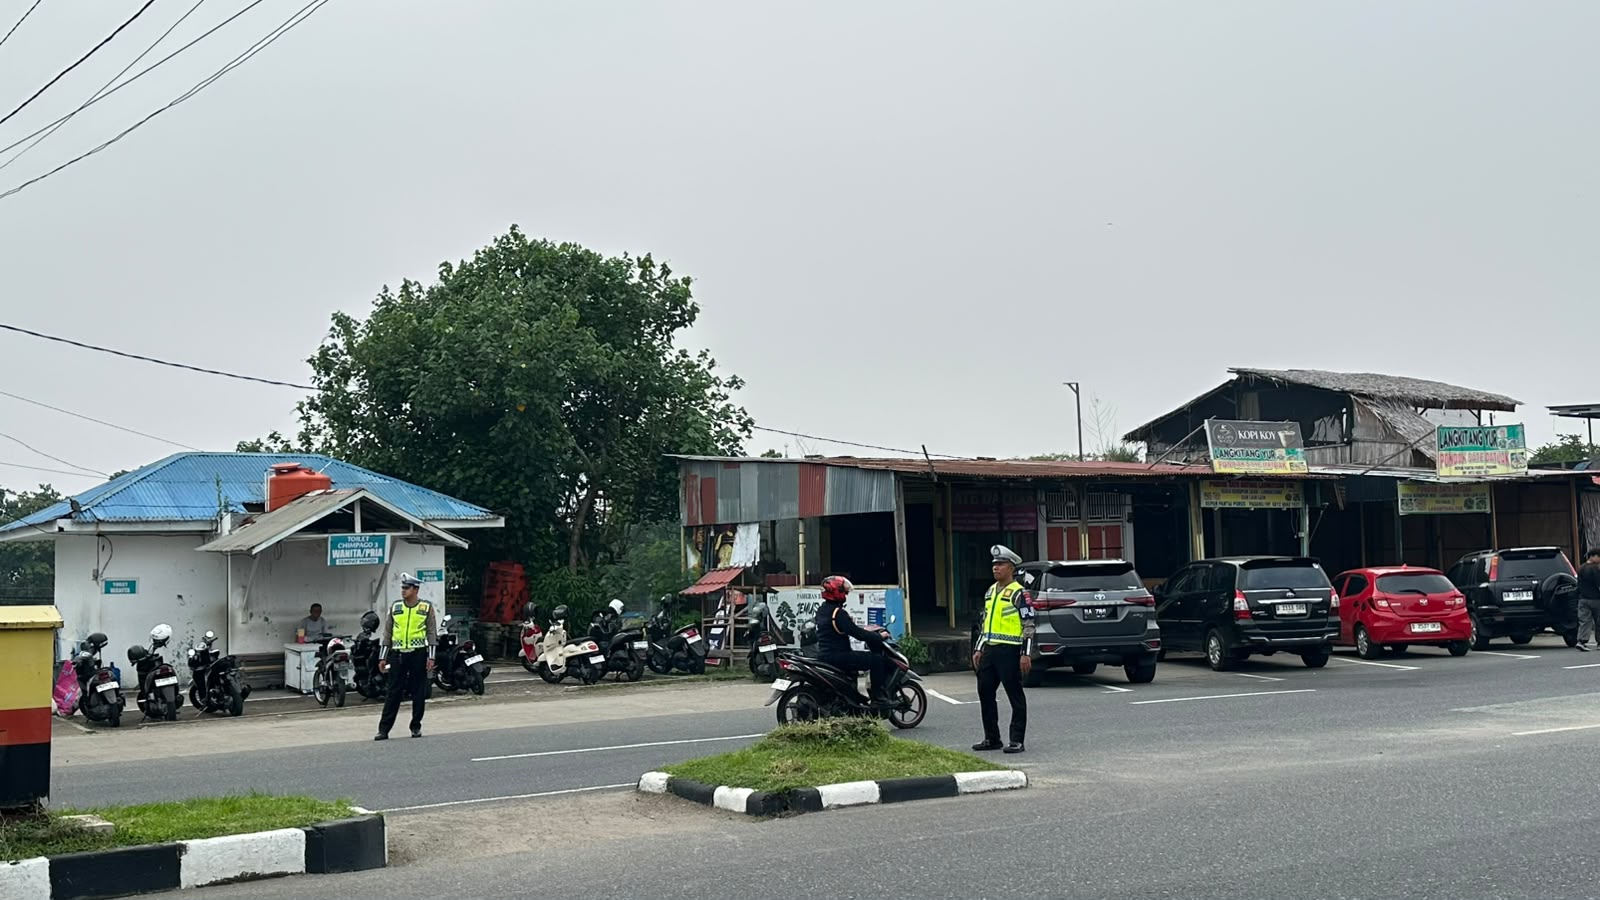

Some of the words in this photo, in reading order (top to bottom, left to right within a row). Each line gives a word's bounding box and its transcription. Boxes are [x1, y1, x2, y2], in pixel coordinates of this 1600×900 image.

[1237, 430, 1258, 440] KOPI
[1259, 430, 1276, 440] KOY
[1439, 429, 1483, 449] LANGKITANG
[1484, 429, 1498, 447] YUR
[1213, 448, 1260, 459] LANGKITANG
[1261, 449, 1276, 459] YUR
[332, 548, 383, 559] WANITA/PRIA
